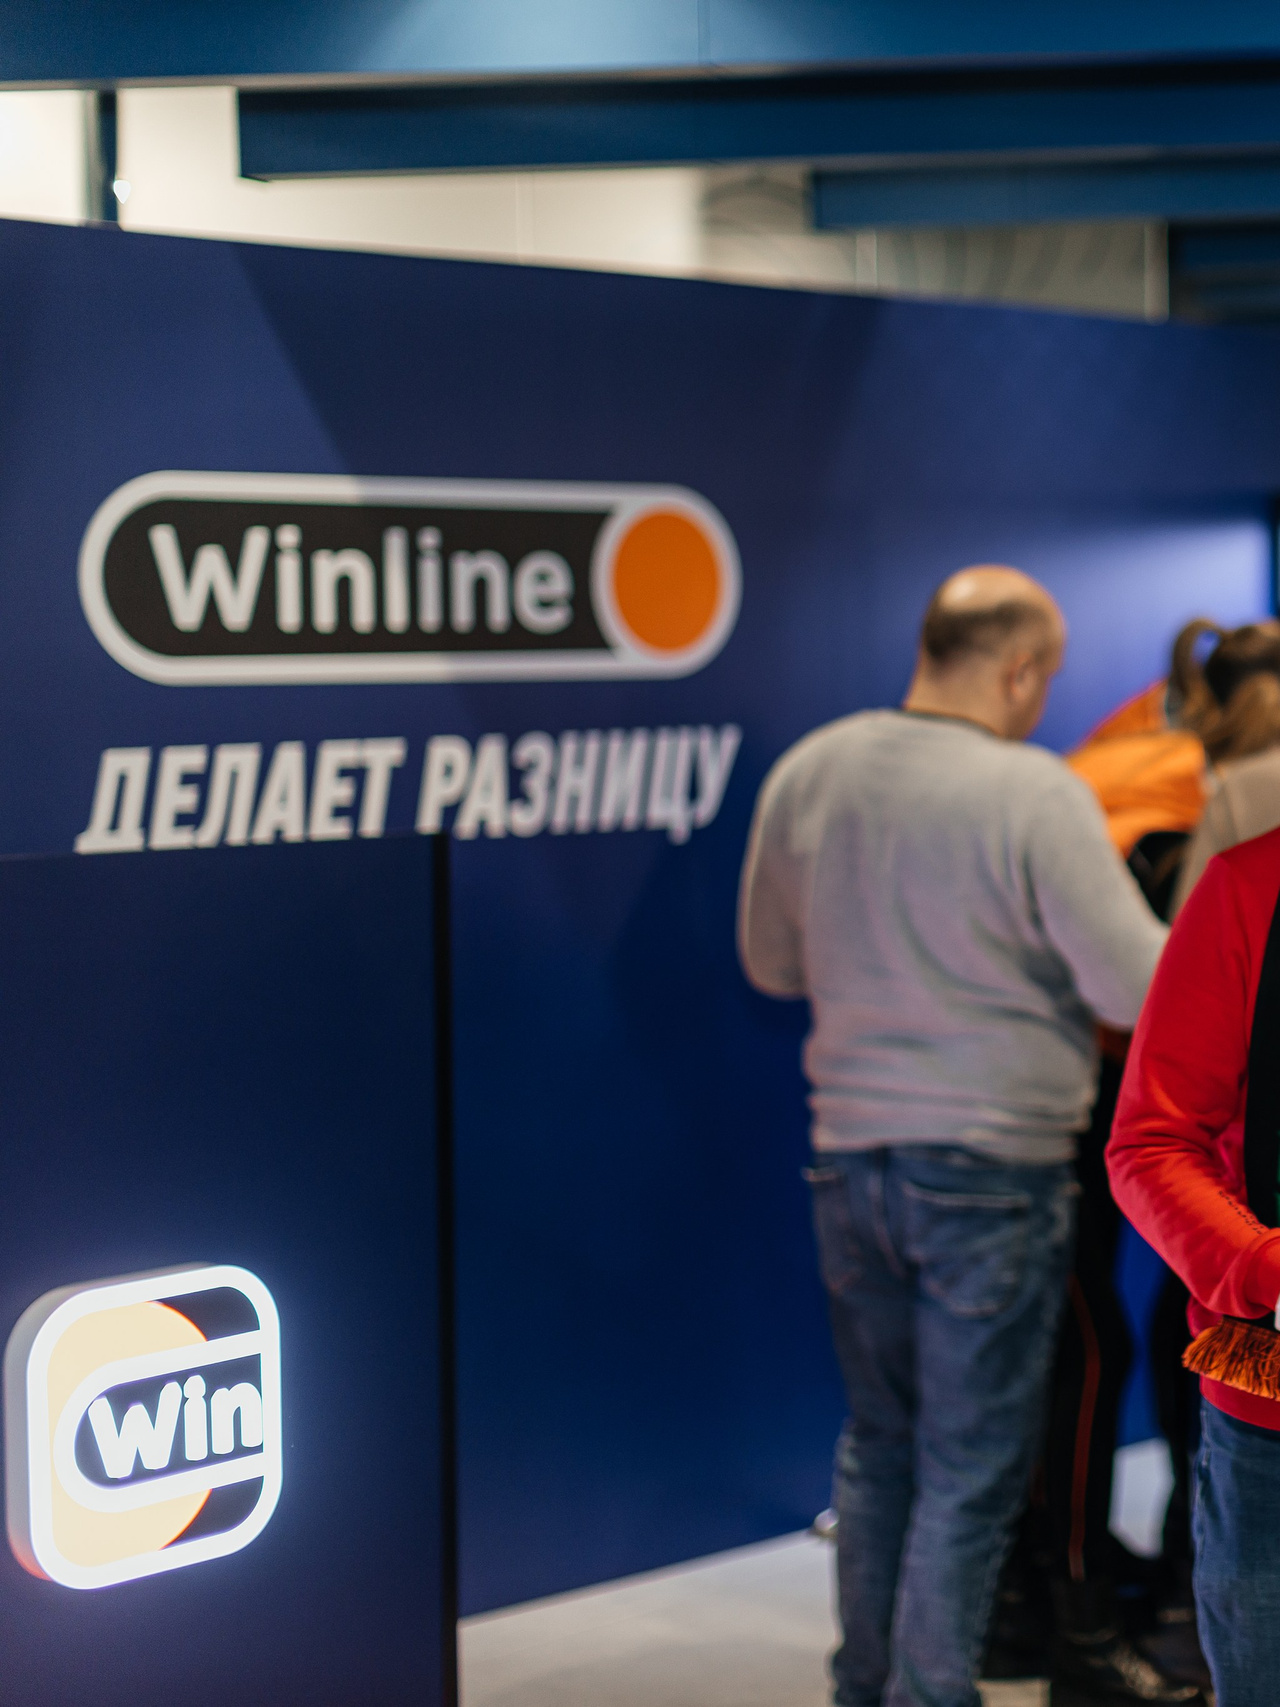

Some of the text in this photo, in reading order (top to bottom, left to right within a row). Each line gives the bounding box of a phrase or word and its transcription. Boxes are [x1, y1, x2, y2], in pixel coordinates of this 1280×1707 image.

[148, 522, 574, 634] Winline
[74, 724, 743, 854] ДЕЛАЕТ РАЗНИЦУ
[88, 1375, 264, 1479] Win
